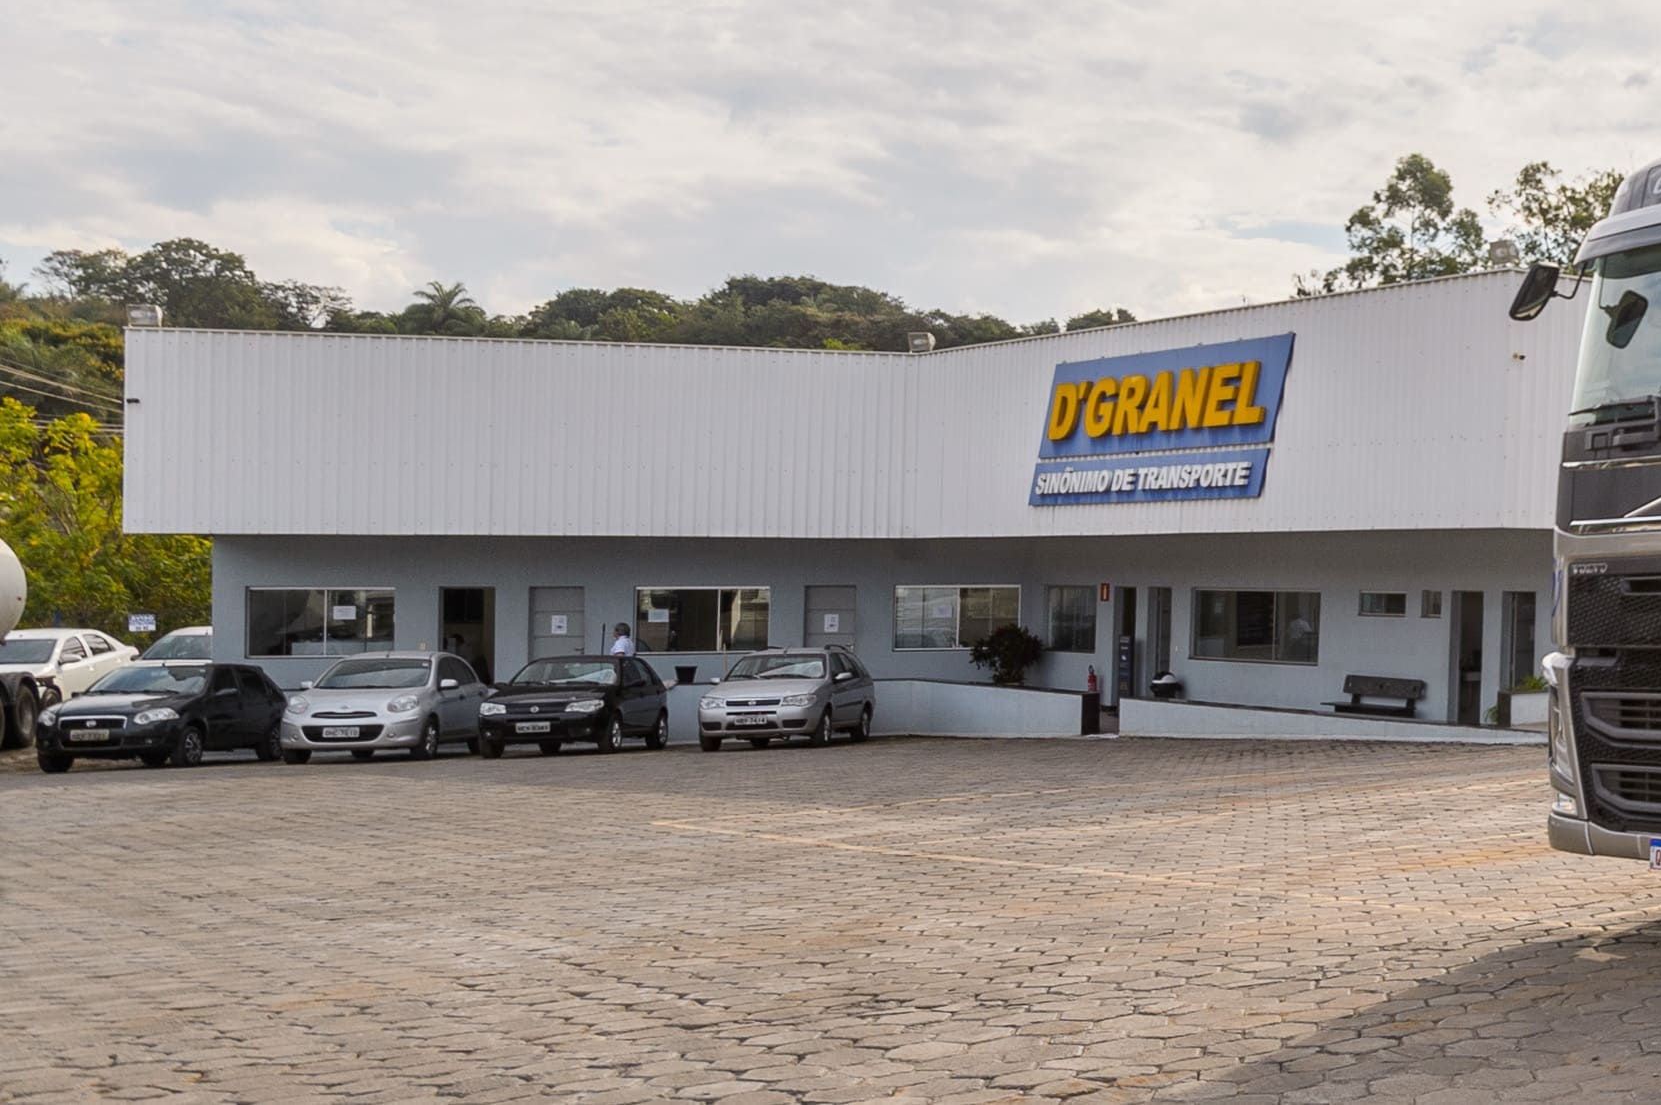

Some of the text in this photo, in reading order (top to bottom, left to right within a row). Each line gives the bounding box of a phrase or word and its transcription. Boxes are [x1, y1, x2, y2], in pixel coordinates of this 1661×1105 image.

[1047, 360, 1267, 442] D'GRANEL
[1035, 461, 1252, 495] SINÔNIMO DE TRANSPORTE
